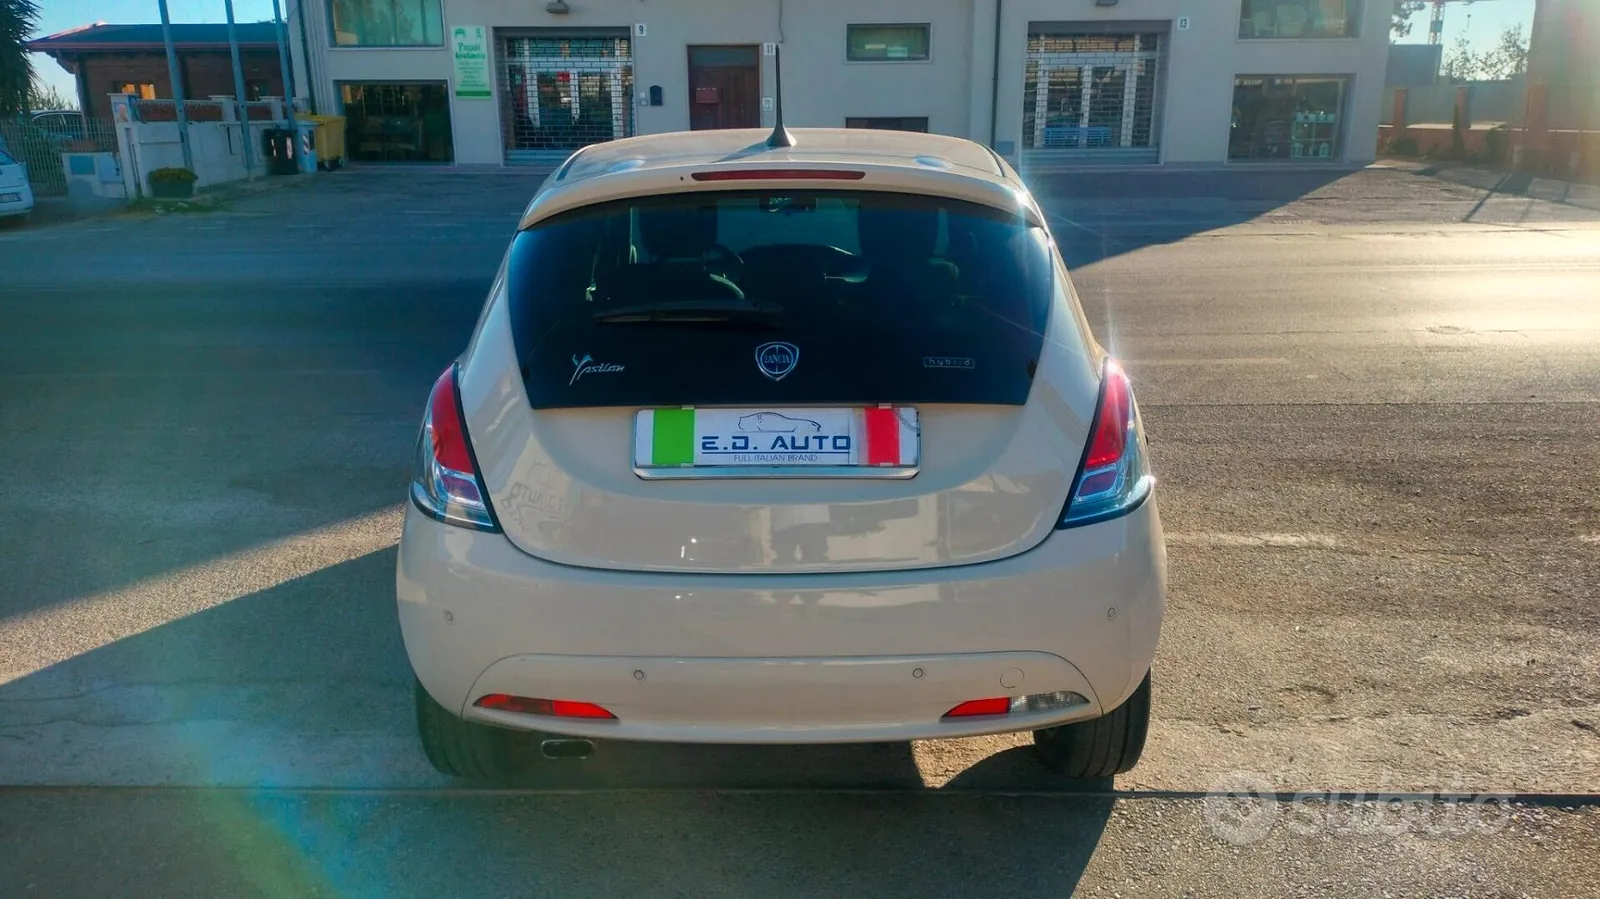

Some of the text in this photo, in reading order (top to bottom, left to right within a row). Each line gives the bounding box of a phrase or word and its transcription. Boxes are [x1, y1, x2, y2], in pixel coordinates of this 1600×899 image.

[638, 24, 645, 35] 9
[766, 43, 774, 54] 11
[764, 354, 791, 364] LANCIA
[569, 353, 625, 386] Ypsilon
[701, 435, 851, 450] E.D. AUTO
[733, 454, 818, 462] FULL ITALIAN BRAND
